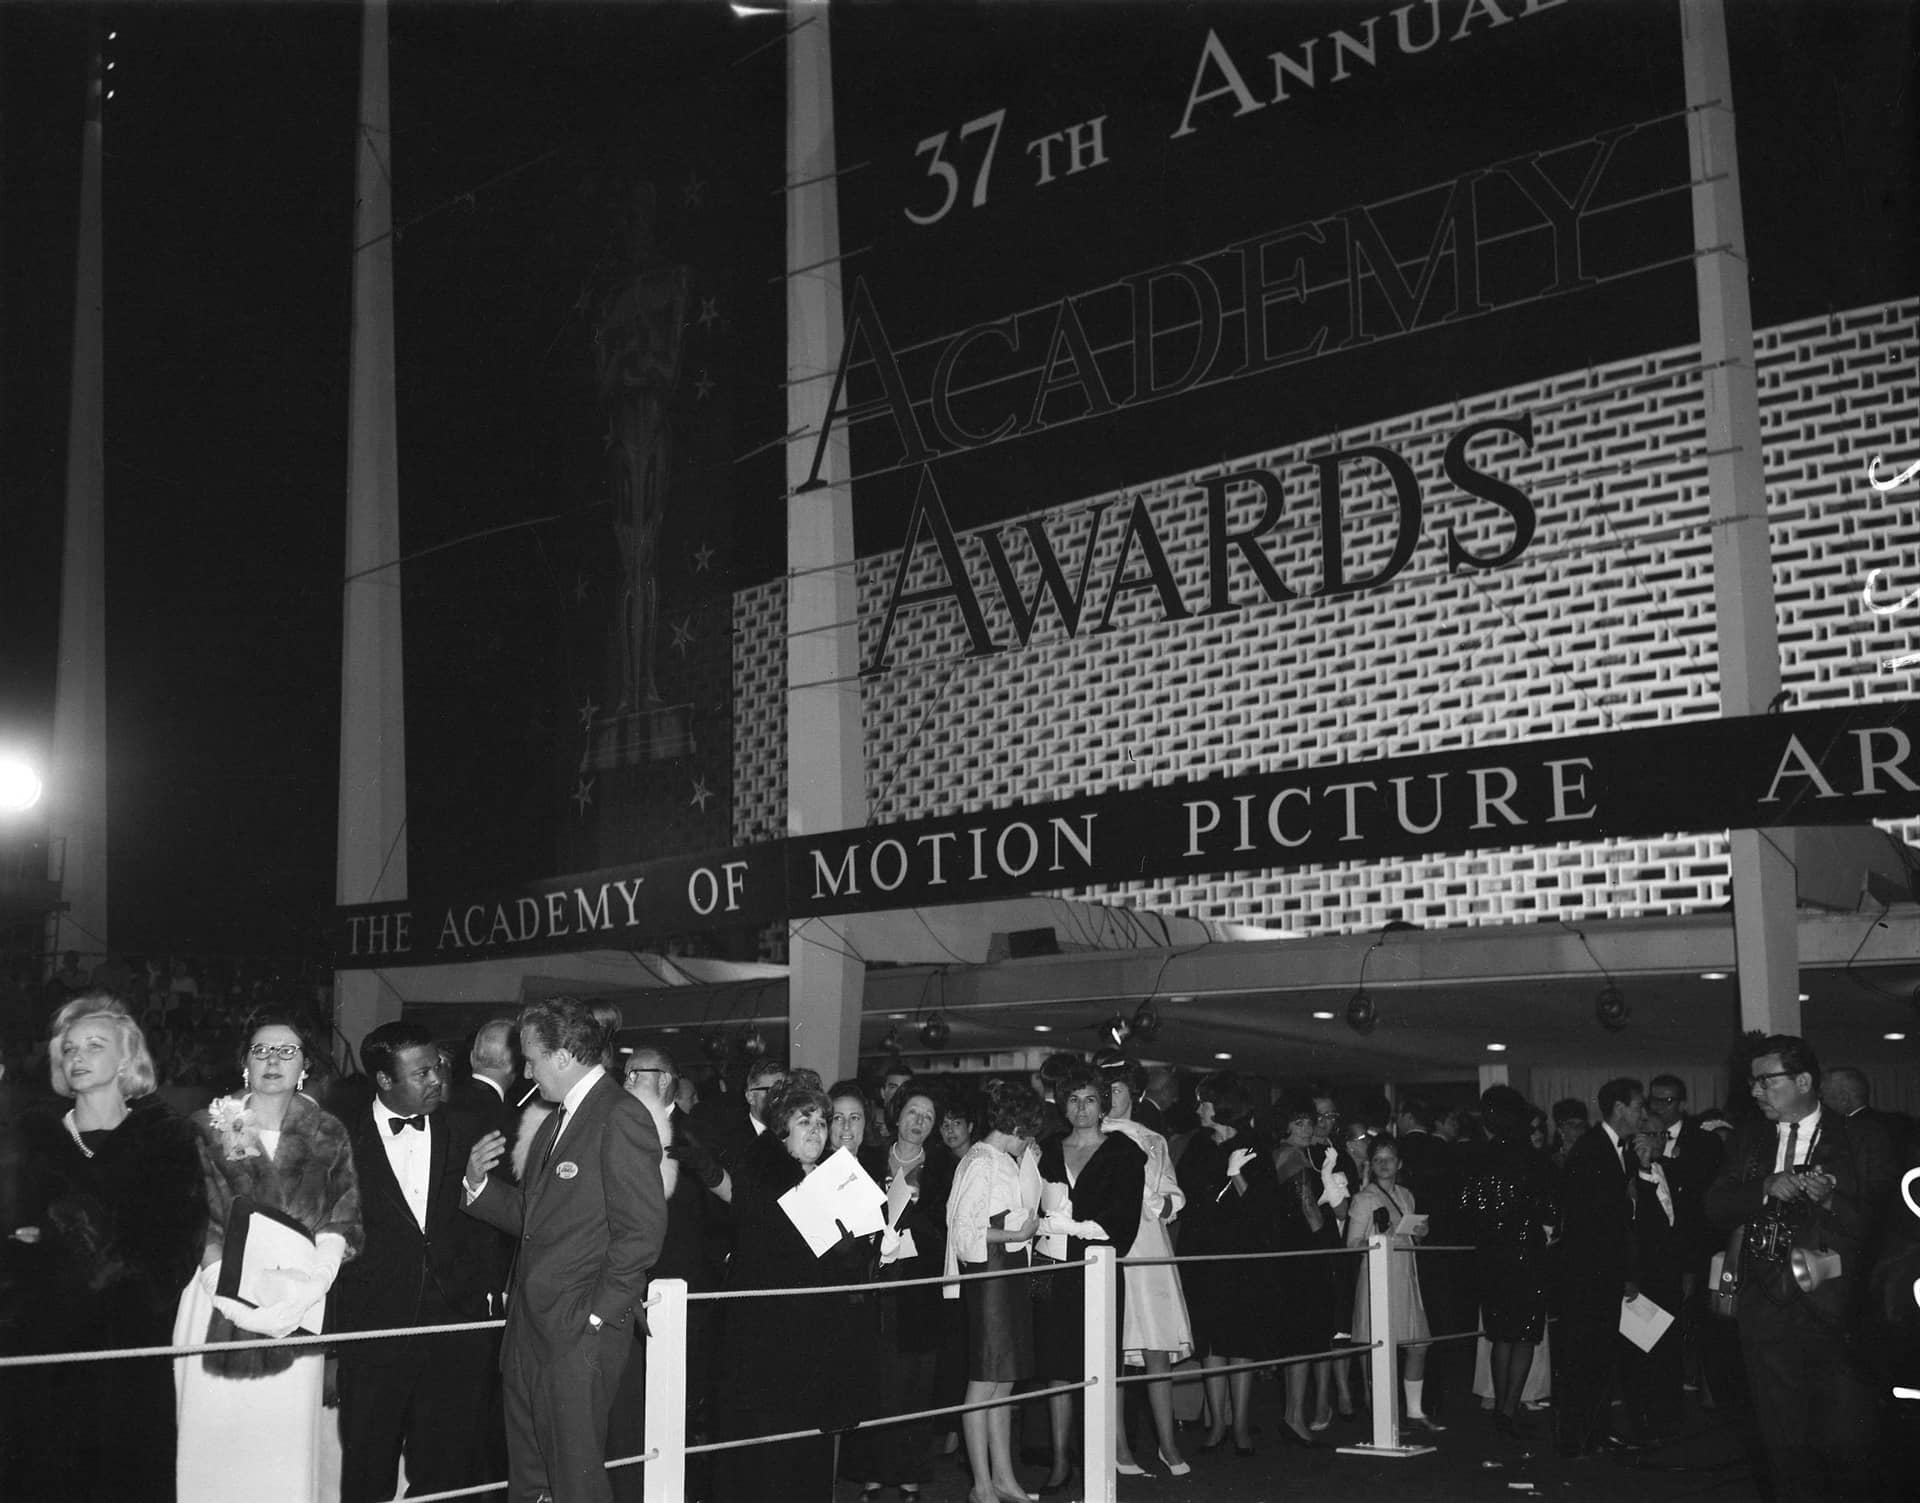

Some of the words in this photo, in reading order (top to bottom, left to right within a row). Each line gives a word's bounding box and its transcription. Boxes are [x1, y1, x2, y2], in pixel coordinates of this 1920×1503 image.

[795, 122, 1640, 495] ACADEMY
[858, 412, 1538, 678] AWARDS
[347, 909, 413, 958] THE
[437, 876, 645, 951] ACADEMY
[687, 861, 749, 916] OF
[809, 813, 1099, 901] MOTION
[1182, 757, 1599, 859] PICTURE
[1757, 726, 1920, 803] AR
